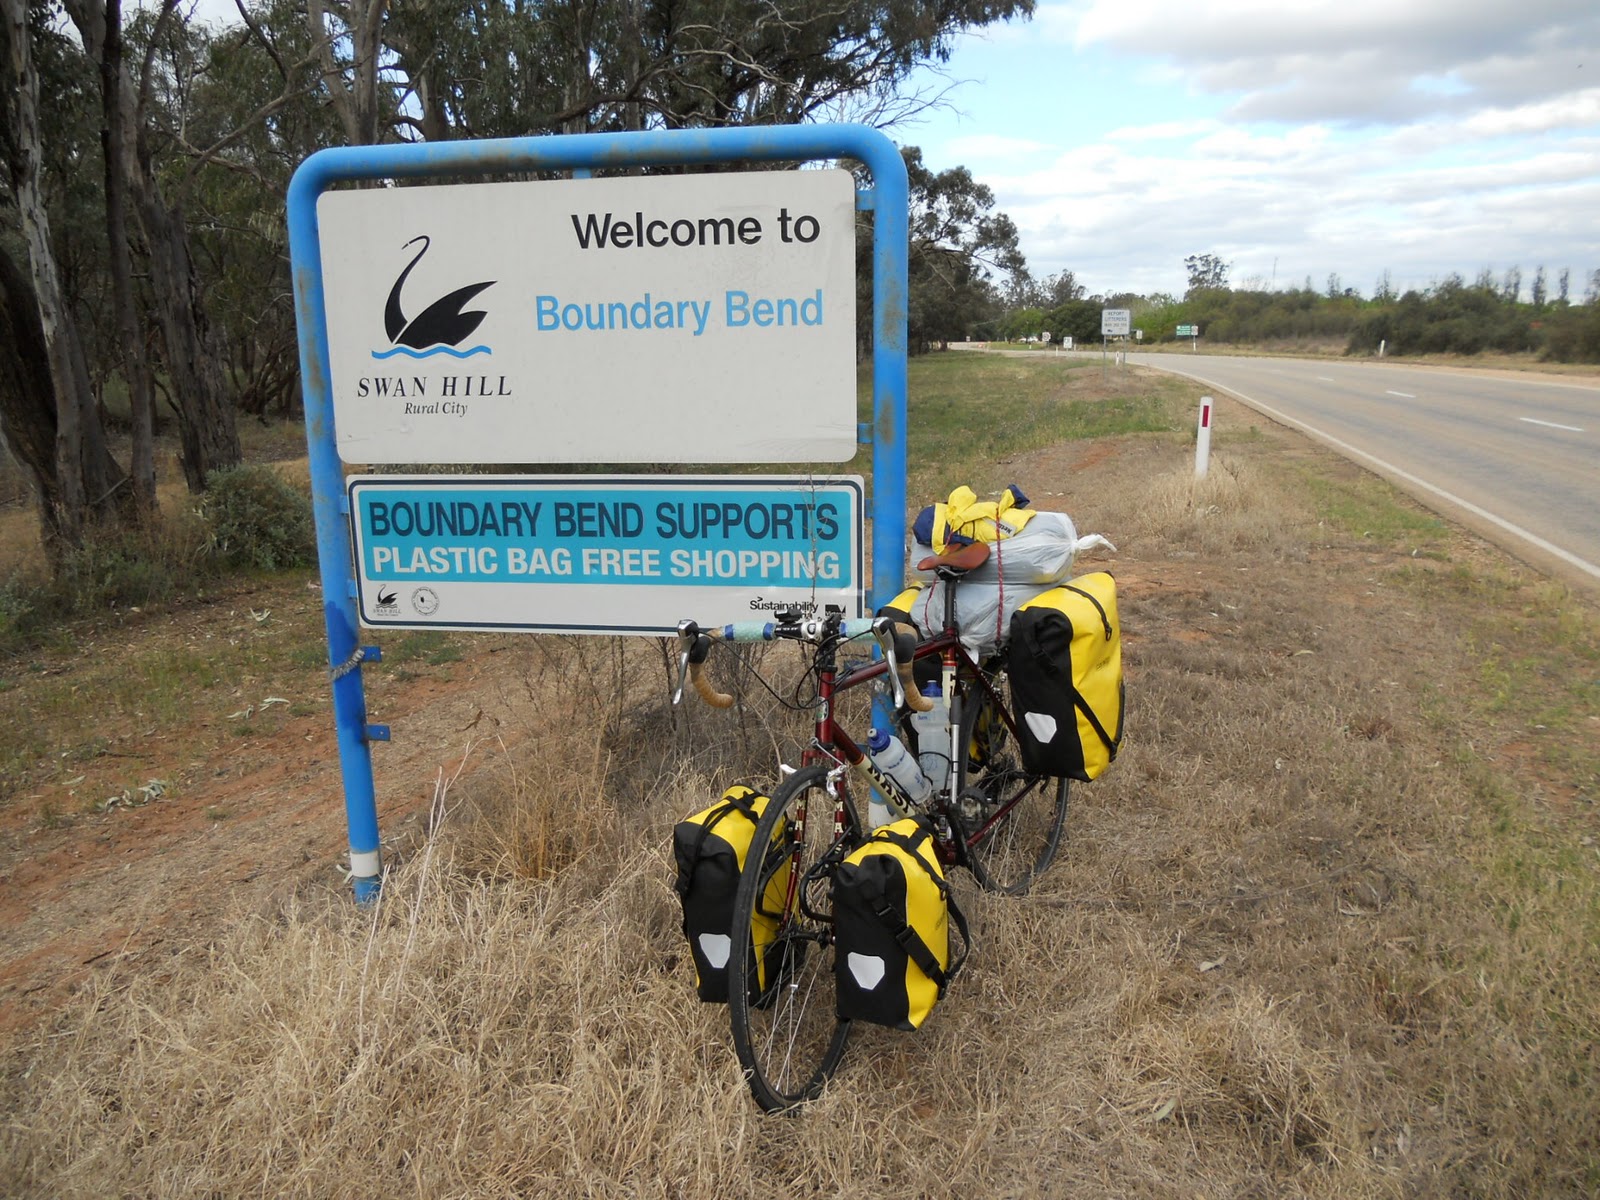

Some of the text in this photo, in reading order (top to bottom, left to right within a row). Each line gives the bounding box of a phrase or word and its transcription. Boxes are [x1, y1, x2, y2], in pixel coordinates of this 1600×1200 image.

[570, 207, 821, 249] Welcome to
[536, 289, 824, 336] Boundary Bend
[357, 375, 512, 398] SWAN HILL
[404, 402, 468, 418] Rural City
[369, 501, 839, 540] BOUNDARY BEND SUPPORTS
[373, 546, 840, 580] PLASTIC BAG FREE SHOPPING
[749, 600, 819, 613] Sustainability
